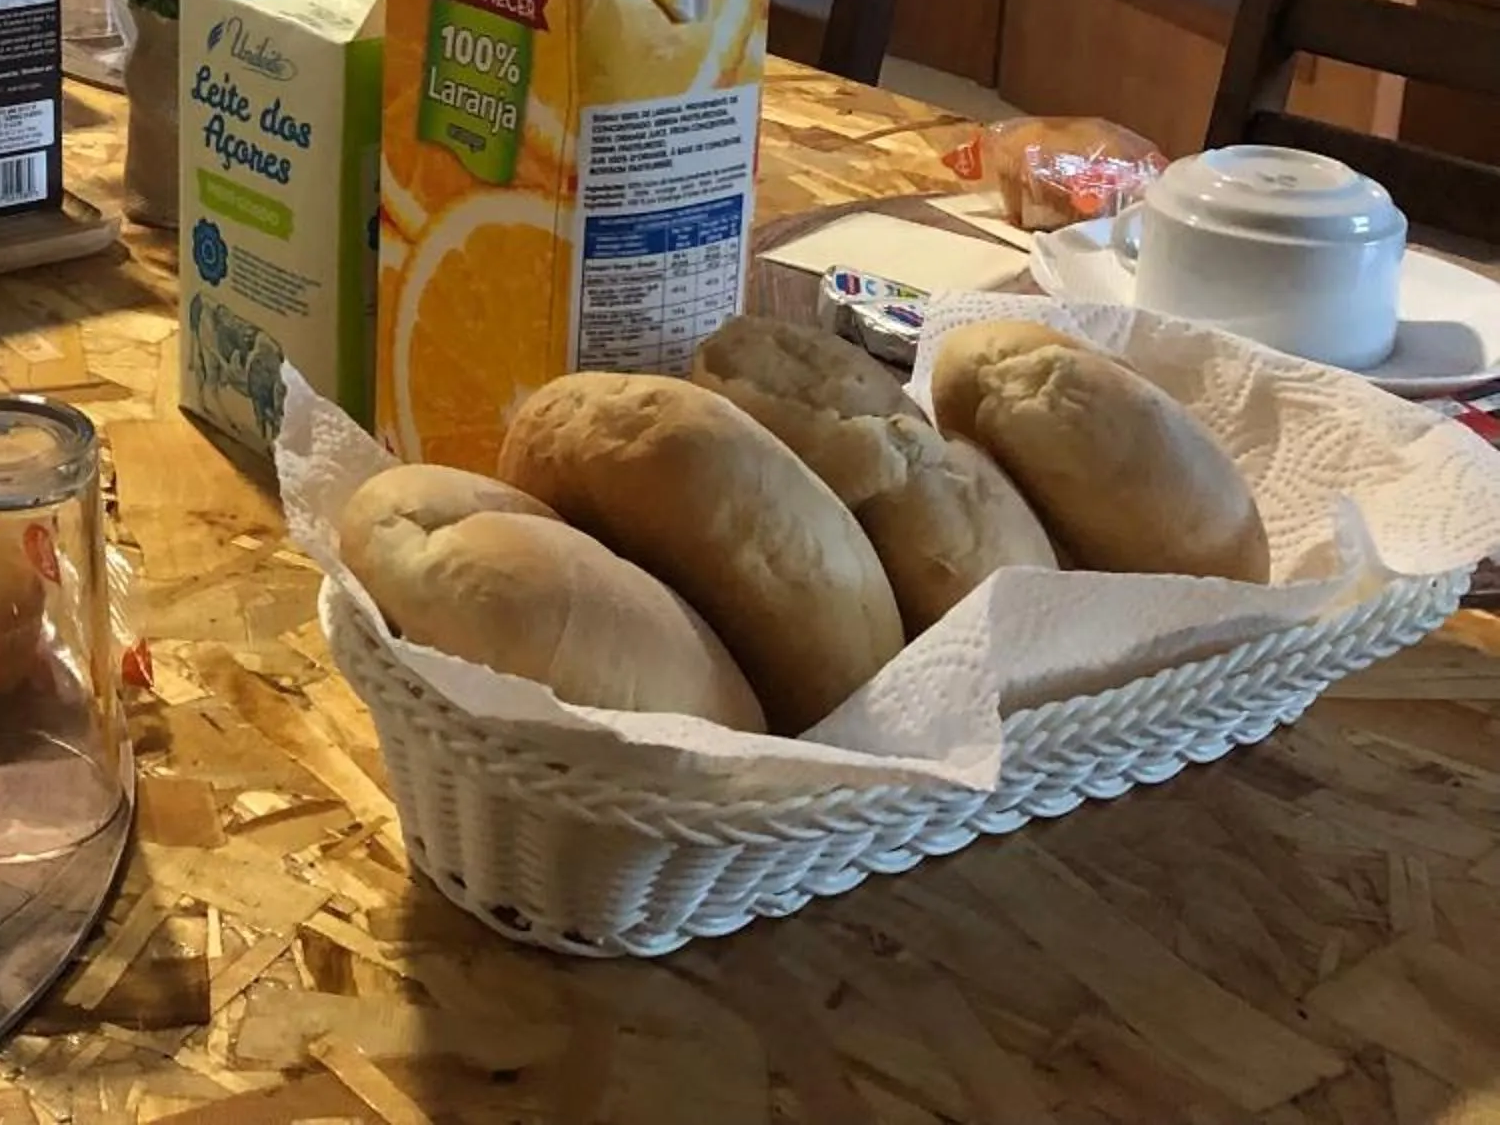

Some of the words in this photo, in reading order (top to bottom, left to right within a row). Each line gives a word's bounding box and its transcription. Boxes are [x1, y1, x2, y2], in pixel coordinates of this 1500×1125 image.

[441, 24, 521, 84] 100%
[192, 64, 251, 122] Leite
[259, 96, 312, 150] dos
[427, 65, 518, 134] Laranja
[203, 113, 292, 186] Açores
